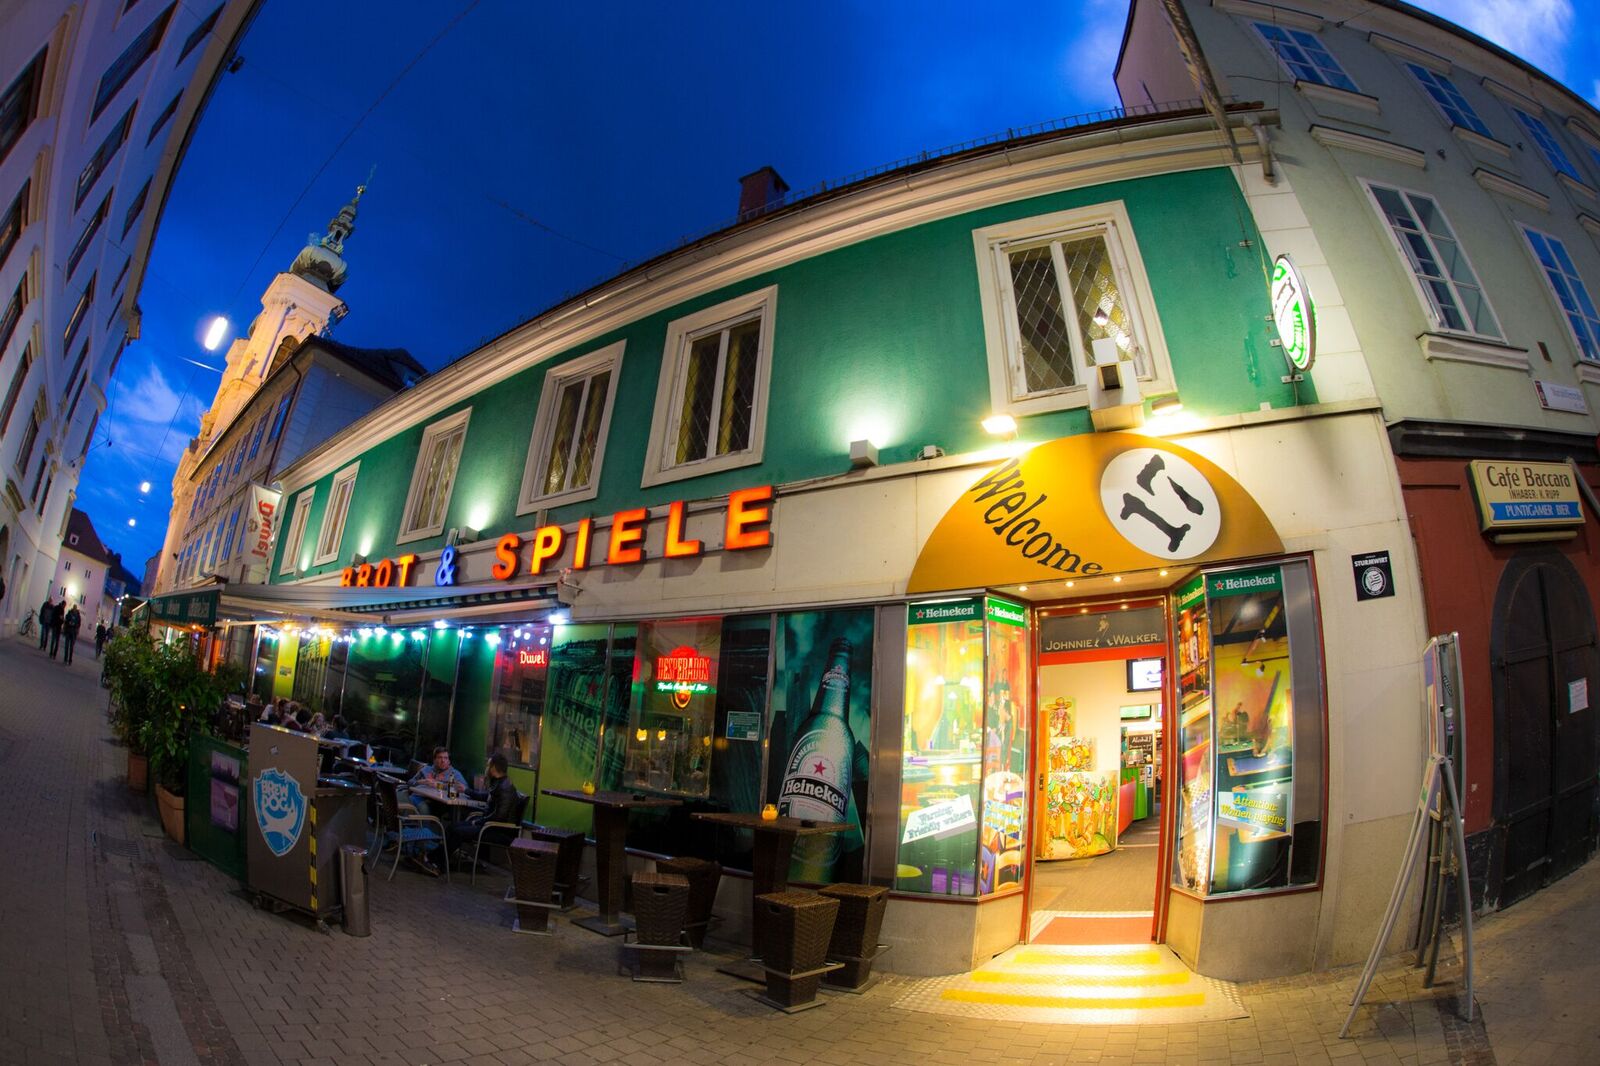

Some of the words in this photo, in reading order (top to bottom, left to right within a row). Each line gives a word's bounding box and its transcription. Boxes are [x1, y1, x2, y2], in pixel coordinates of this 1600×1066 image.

[1486, 465, 1521, 488] Café
[1523, 467, 1571, 487] Baccara
[970, 457, 1104, 575] Welcome
[1505, 504, 1553, 517] PUNTIGAMER
[1555, 504, 1571, 516] BIER
[251, 500, 275, 558] Duvel
[340, 552, 417, 589] BROT
[435, 543, 458, 587] &
[491, 485, 775, 581] SPIELE
[1353, 556, 1388, 567] STURMWIRT
[1226, 575, 1276, 590] Heineken
[925, 605, 975, 618] Heineken
[1046, 639, 1093, 651] JOHNNIE
[519, 650, 546, 665] Duvel
[657, 657, 710, 682] DESPERADOS
[261, 780, 288, 798] BREW
[784, 779, 847, 813] Heineken
[262, 793, 288, 811] DOG
